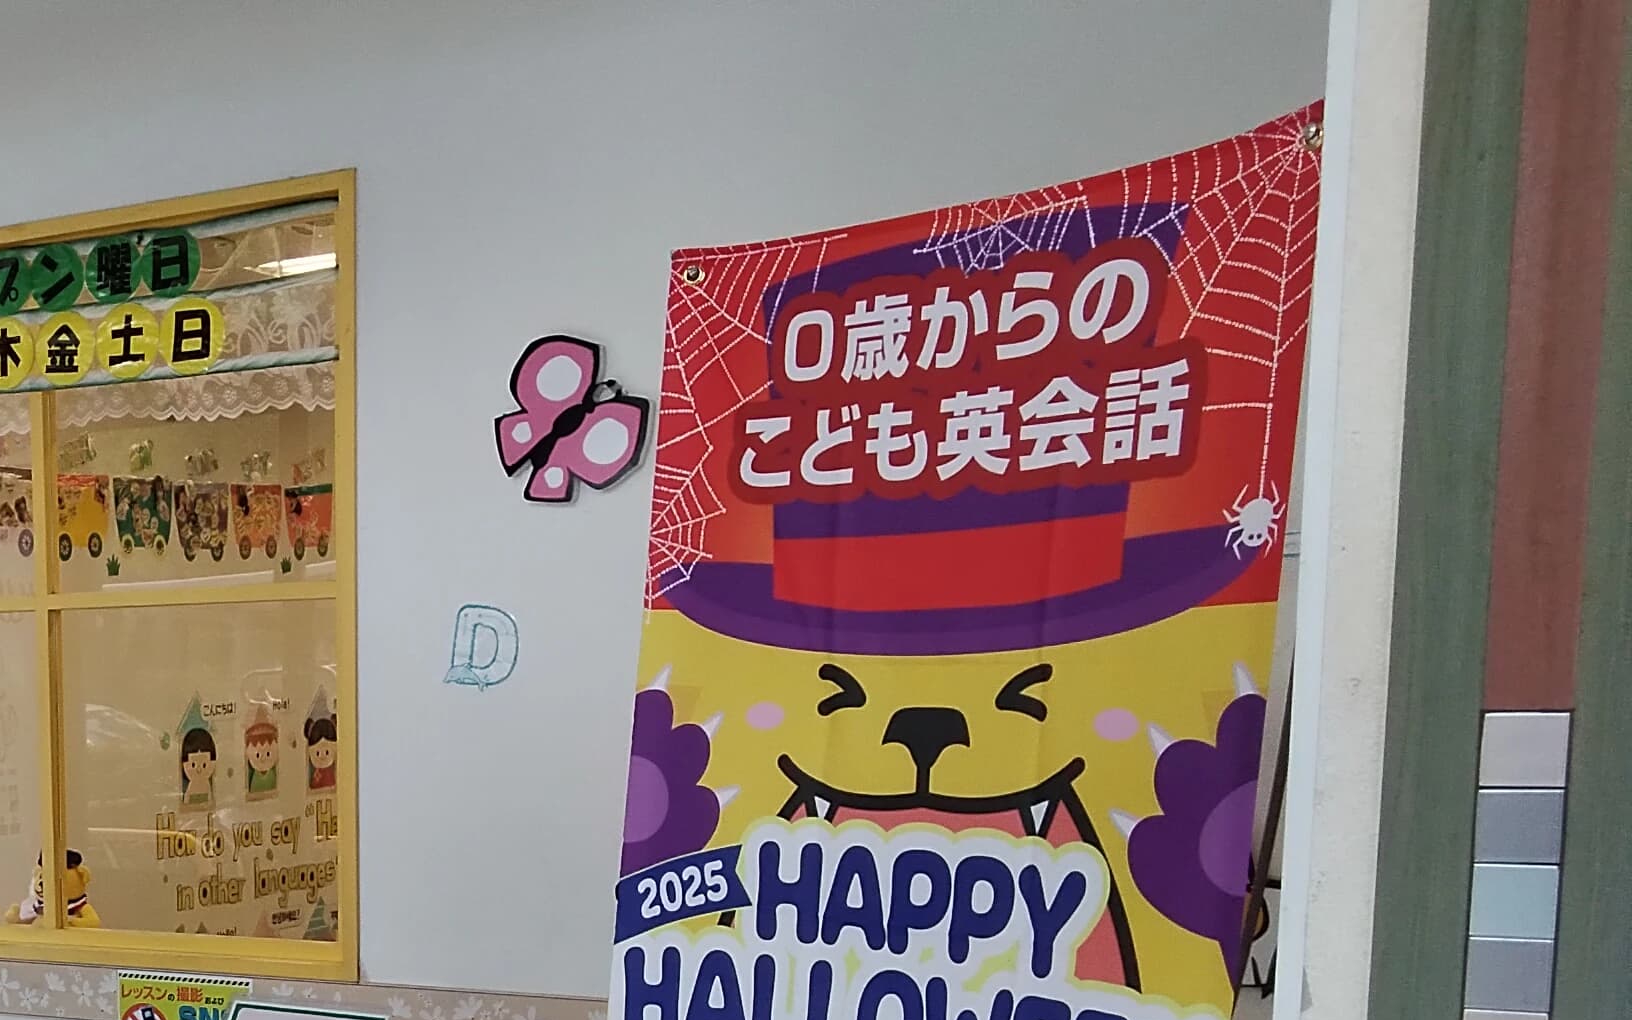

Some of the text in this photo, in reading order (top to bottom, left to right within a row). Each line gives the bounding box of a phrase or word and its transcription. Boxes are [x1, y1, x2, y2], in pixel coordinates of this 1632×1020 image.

[785, 257, 1150, 384] 0歳からの
[738, 357, 1193, 489] こども英会話
[448, 603, 520, 687] D
[155, 811, 301, 863] How do you say
[176, 882, 195, 912] in
[198, 861, 246, 907] other
[637, 859, 729, 919] 2025
[756, 841, 1087, 979] HAPPY
